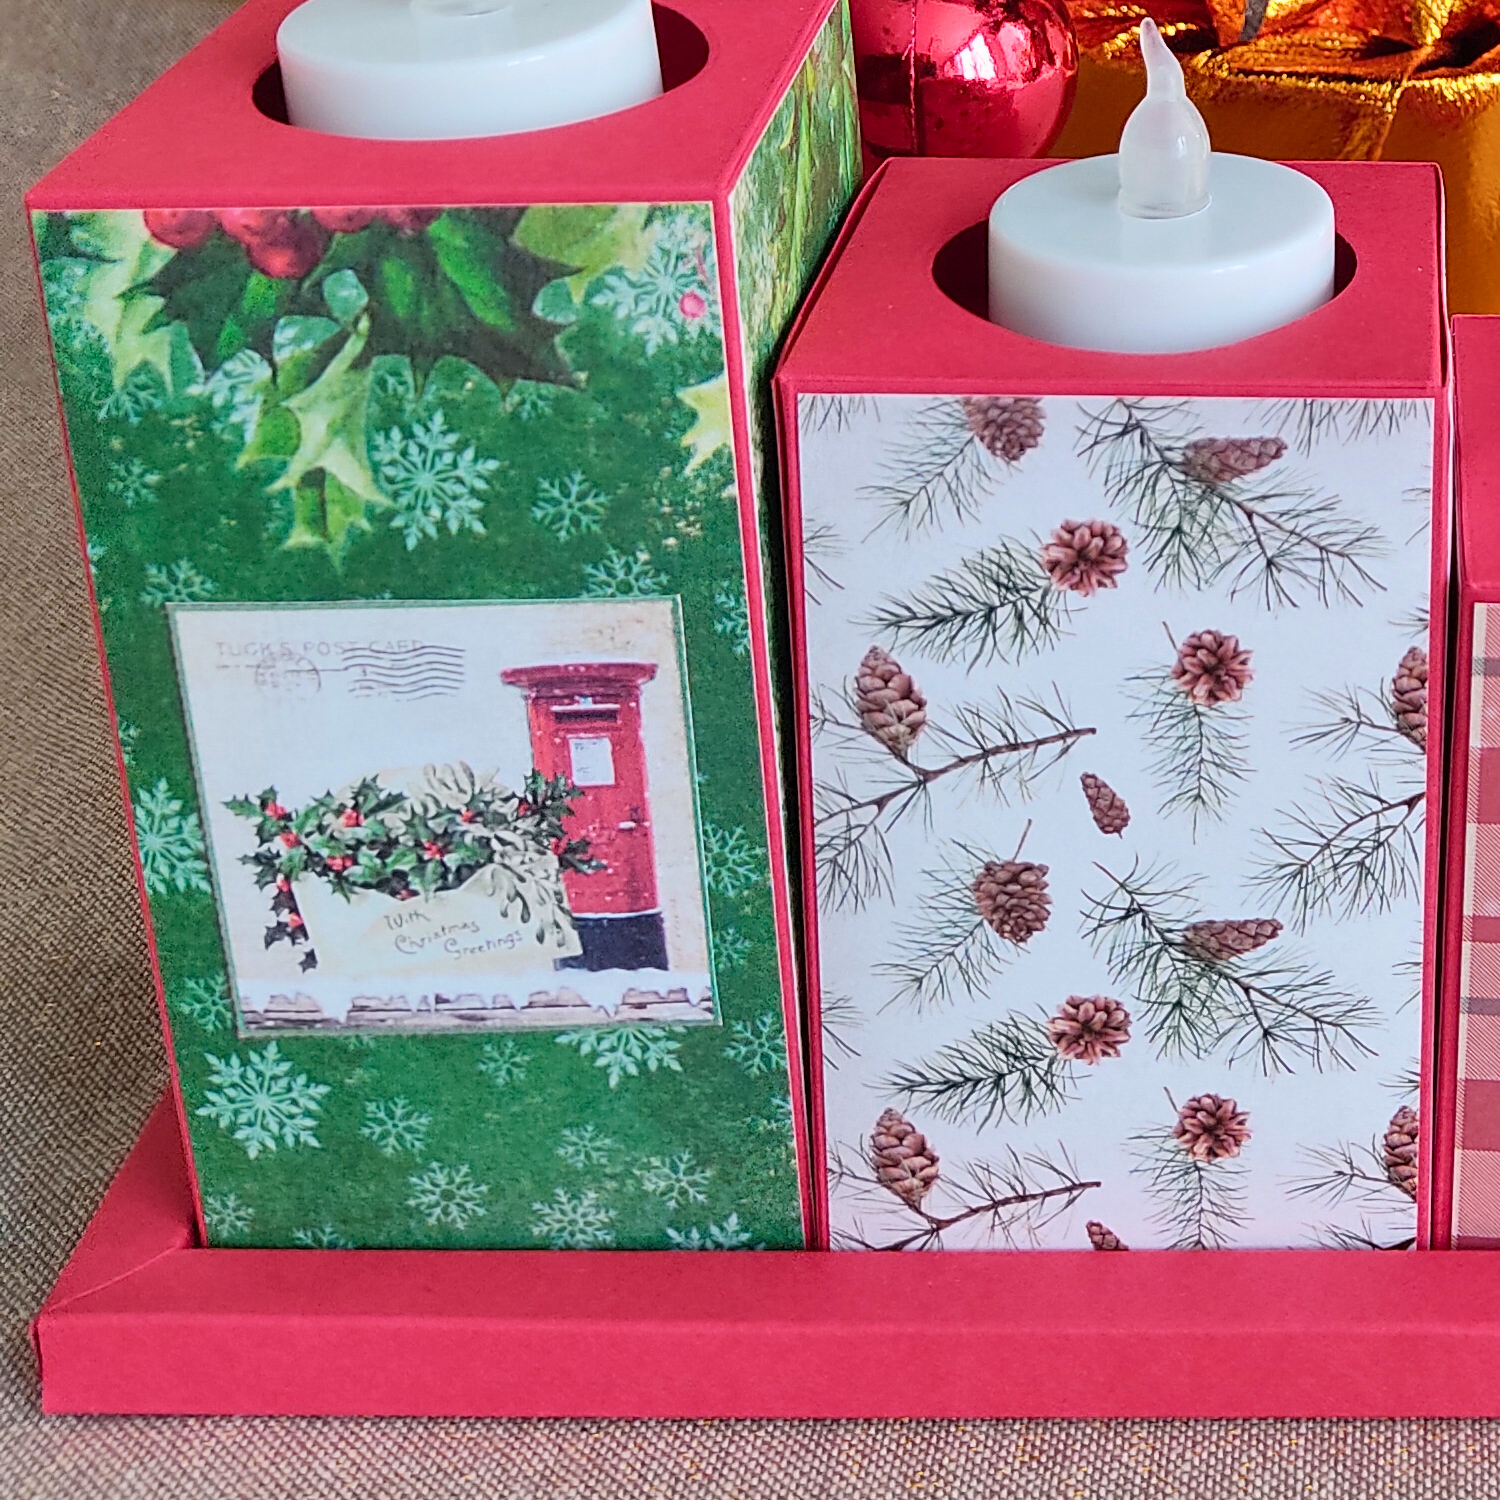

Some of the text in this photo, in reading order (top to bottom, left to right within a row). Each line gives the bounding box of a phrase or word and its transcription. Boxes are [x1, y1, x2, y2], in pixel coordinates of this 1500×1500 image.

[383, 910, 432, 931] With
[394, 921, 481, 956] Christmas
[444, 930, 524, 961] Greetings
